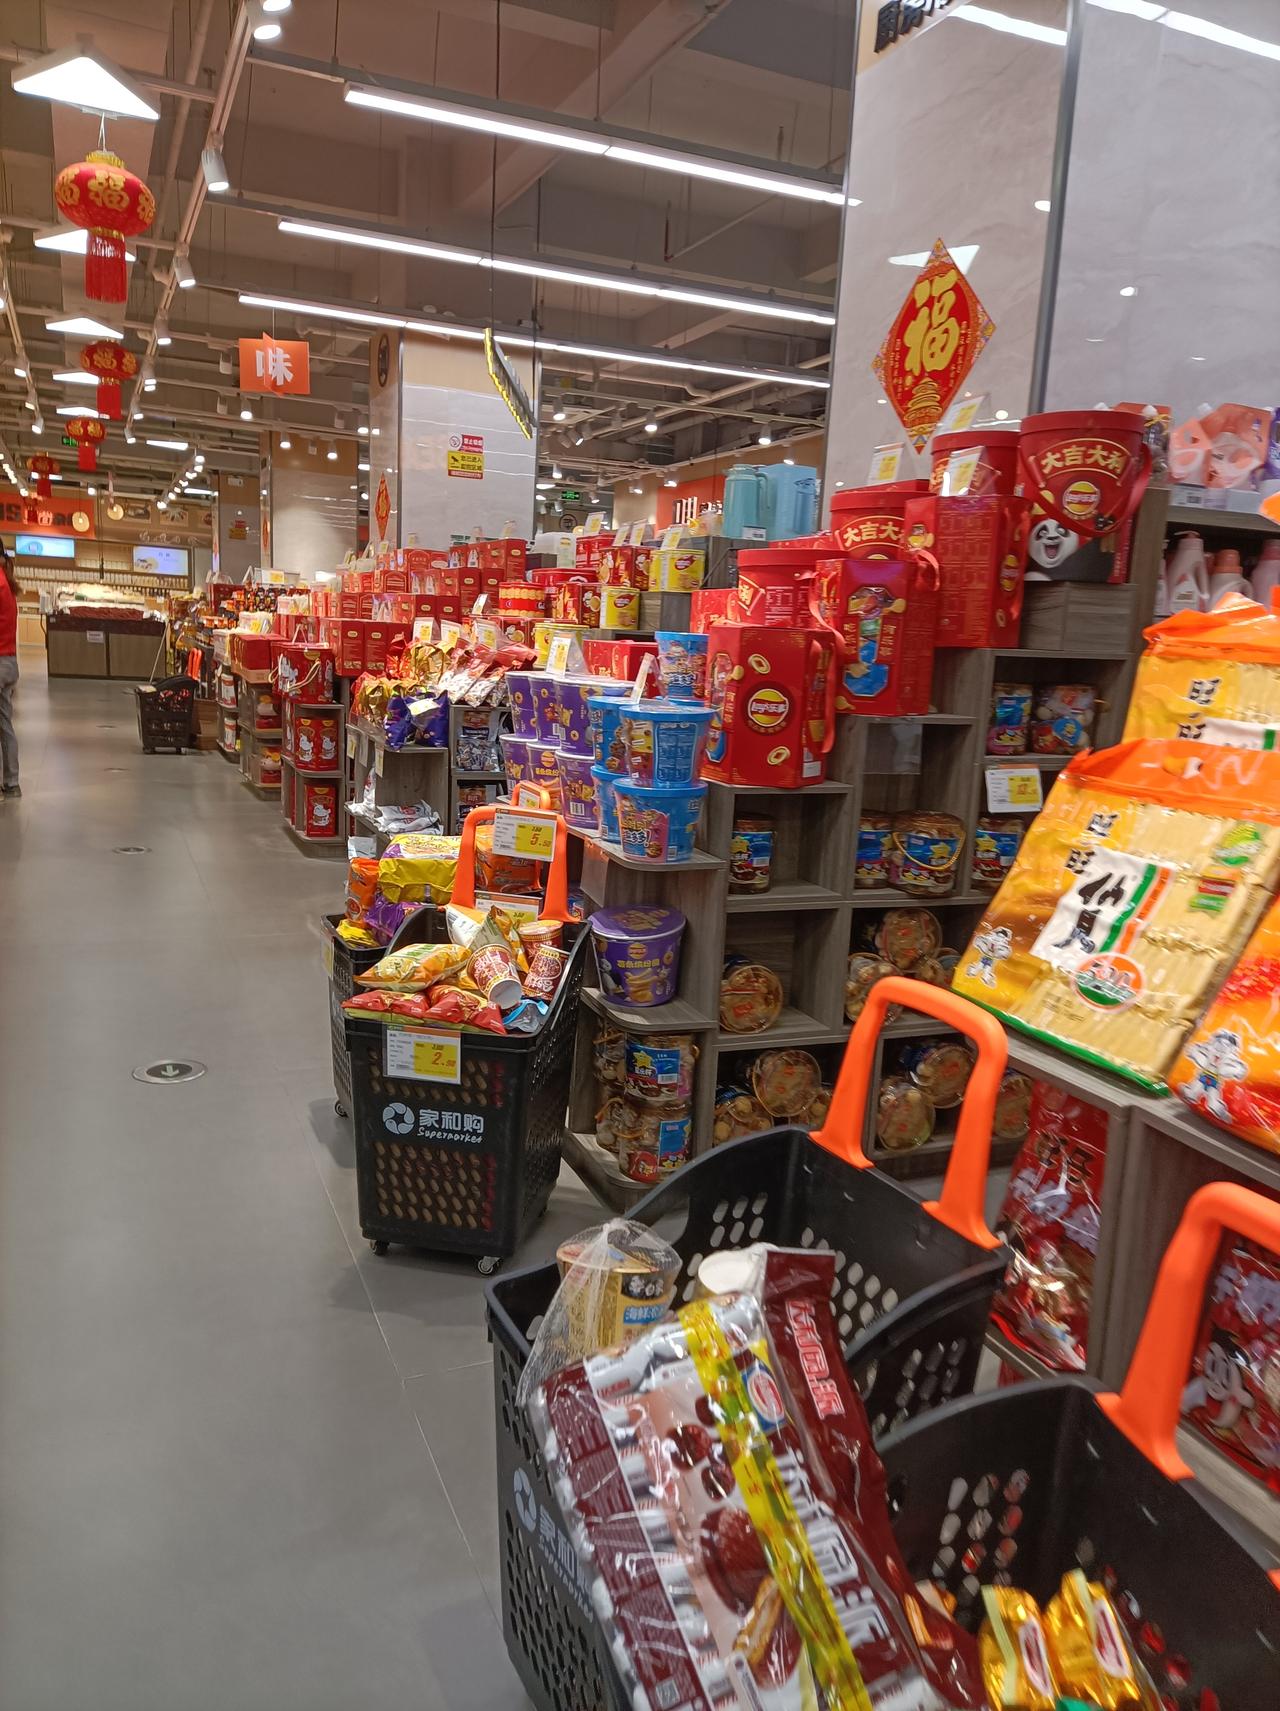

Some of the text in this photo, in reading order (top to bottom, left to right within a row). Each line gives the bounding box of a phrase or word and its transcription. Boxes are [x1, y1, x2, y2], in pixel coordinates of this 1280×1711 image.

[904, 269, 960, 375] 福
[1040, 445, 1128, 475] 大吉大利
[843, 521, 904, 547] 大吉大
[419, 1109, 485, 1134] 家和购
[417, 1127, 482, 1144] Supermarket
